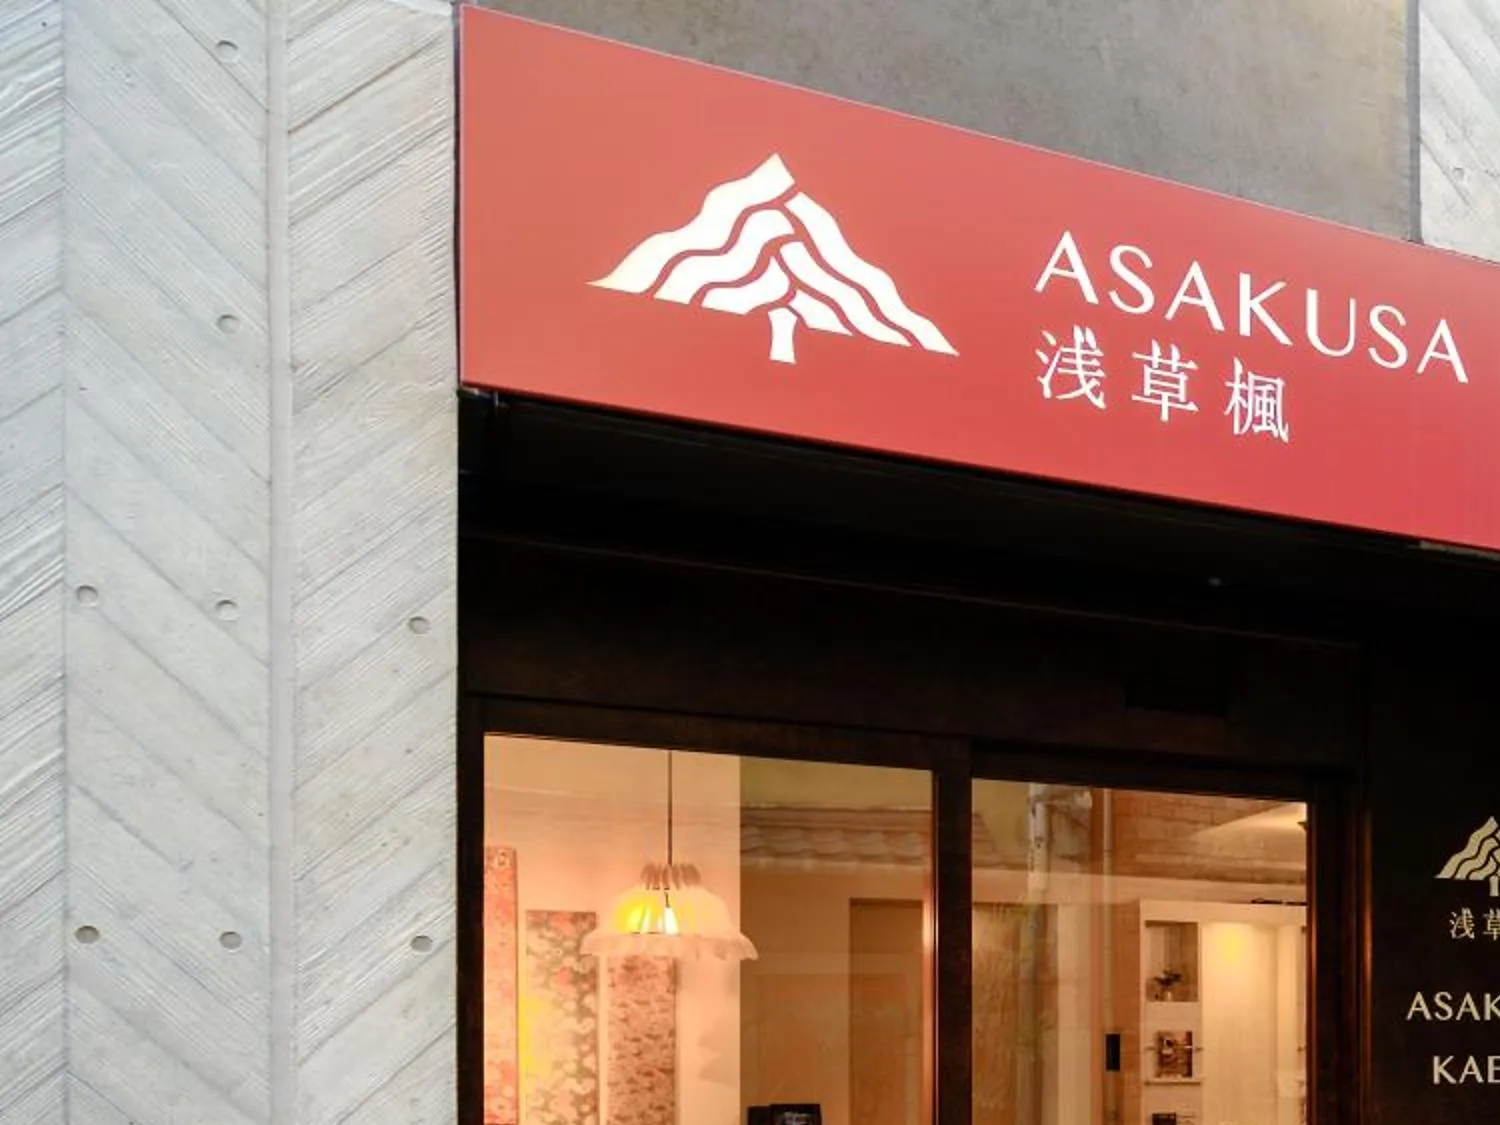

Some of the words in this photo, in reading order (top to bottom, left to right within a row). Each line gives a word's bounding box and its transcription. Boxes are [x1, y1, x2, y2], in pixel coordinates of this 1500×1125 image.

[1034, 230, 1469, 383] ASAKUSA
[1035, 325, 1290, 443] 浅草楓
